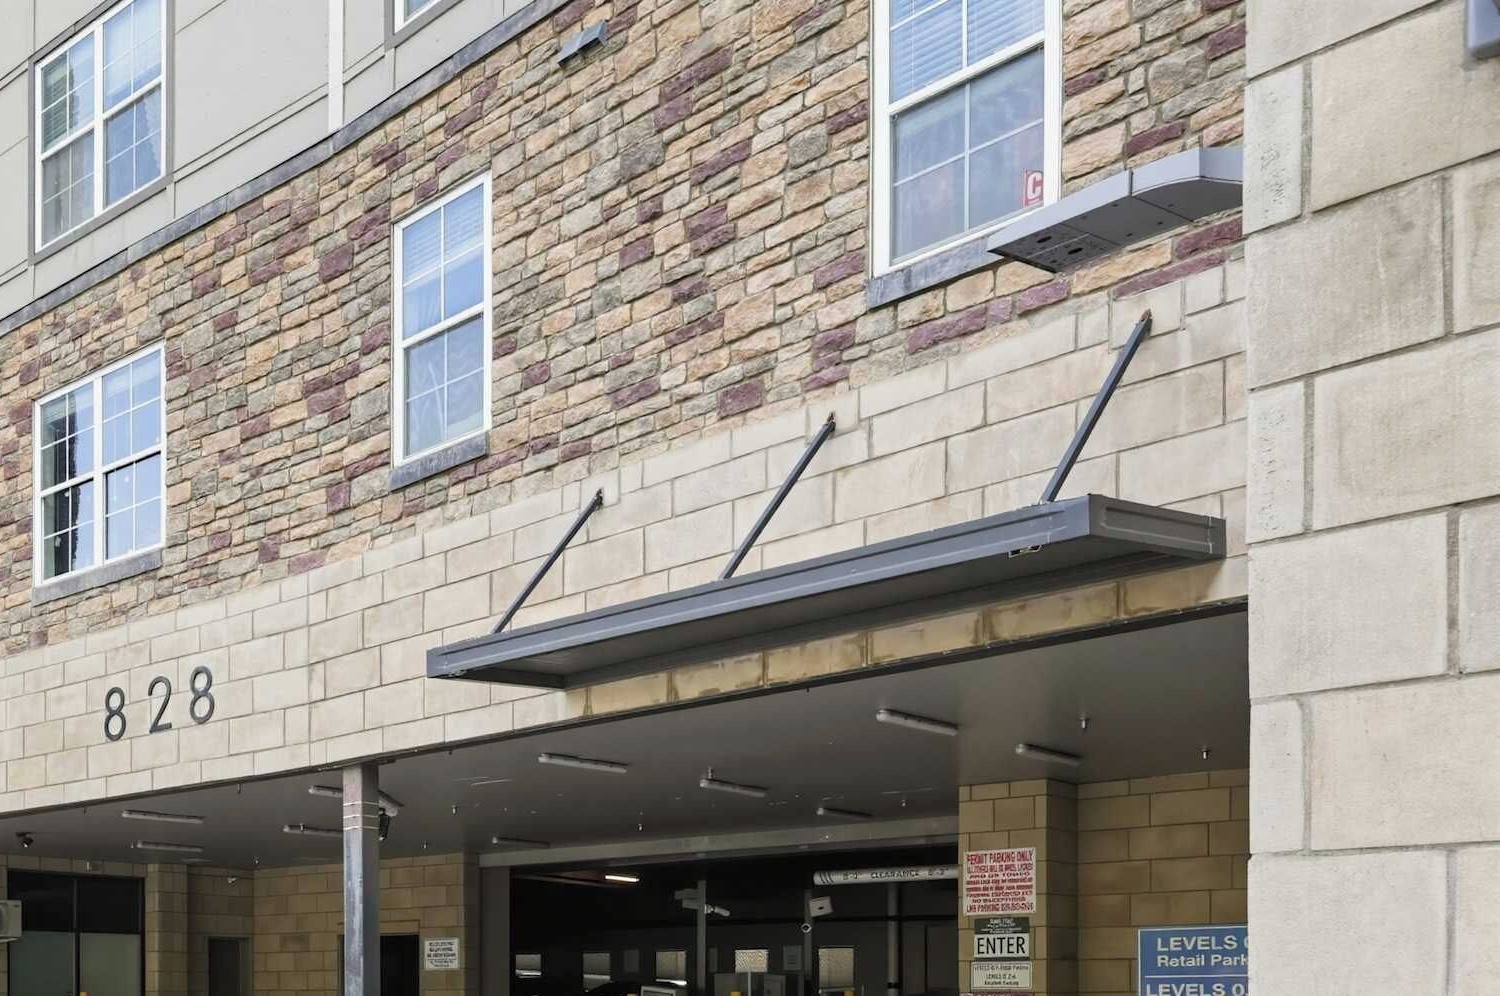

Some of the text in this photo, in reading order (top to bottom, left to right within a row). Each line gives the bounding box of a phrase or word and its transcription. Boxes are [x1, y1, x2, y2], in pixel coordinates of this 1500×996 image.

[104, 665, 215, 741] 828
[1017, 849, 1033, 861] ONLY
[977, 936, 1026, 955] ENTER
[1157, 935, 1238, 952] LEVELS
[1156, 954, 1205, 967] Retail
